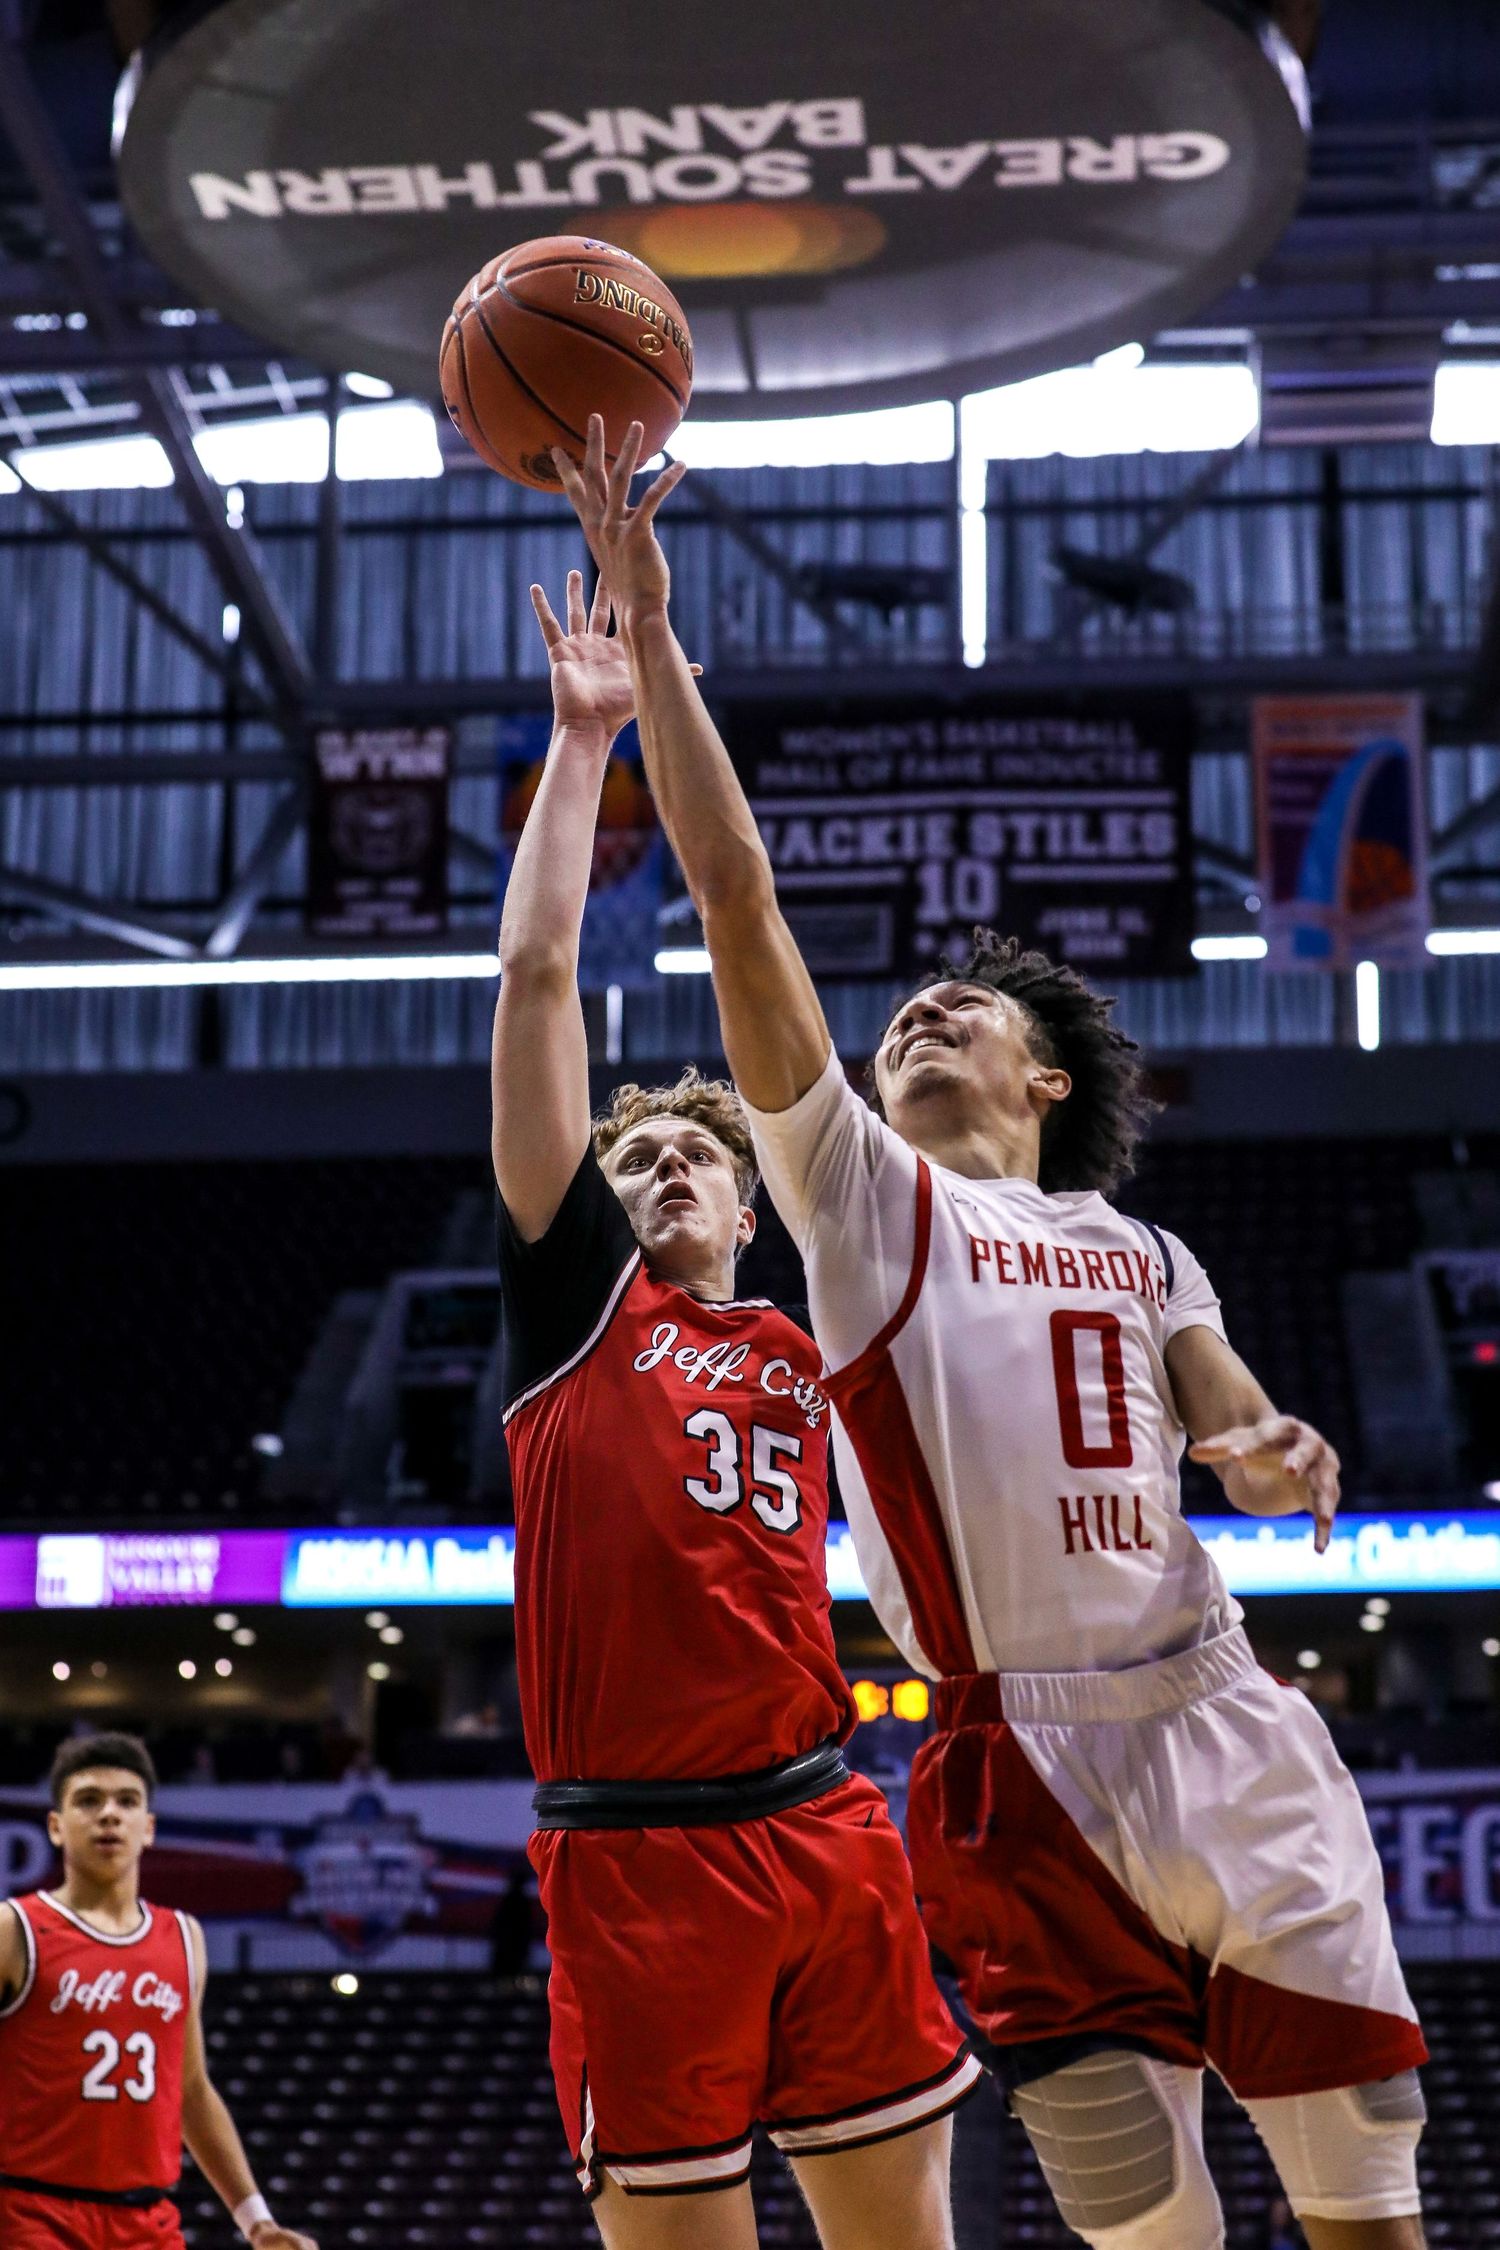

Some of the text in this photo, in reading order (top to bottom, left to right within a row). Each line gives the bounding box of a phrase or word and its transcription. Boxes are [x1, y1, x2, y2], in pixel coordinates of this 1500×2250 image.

[527, 97, 867, 160] BANK
[190, 130, 1231, 220] GREAT SOUTHERN
[573, 269, 693, 382] PALDING
[968, 811, 1176, 860] STILES
[915, 860, 998, 926] 10
[633, 1321, 828, 1430] Jeff City
[1050, 1309, 1133, 1469] 0
[683, 1406, 804, 1536] 35
[1057, 1495, 1152, 1555] HILL
[50, 1968, 183, 2022] Jeff City
[81, 2028, 157, 2102] 23
